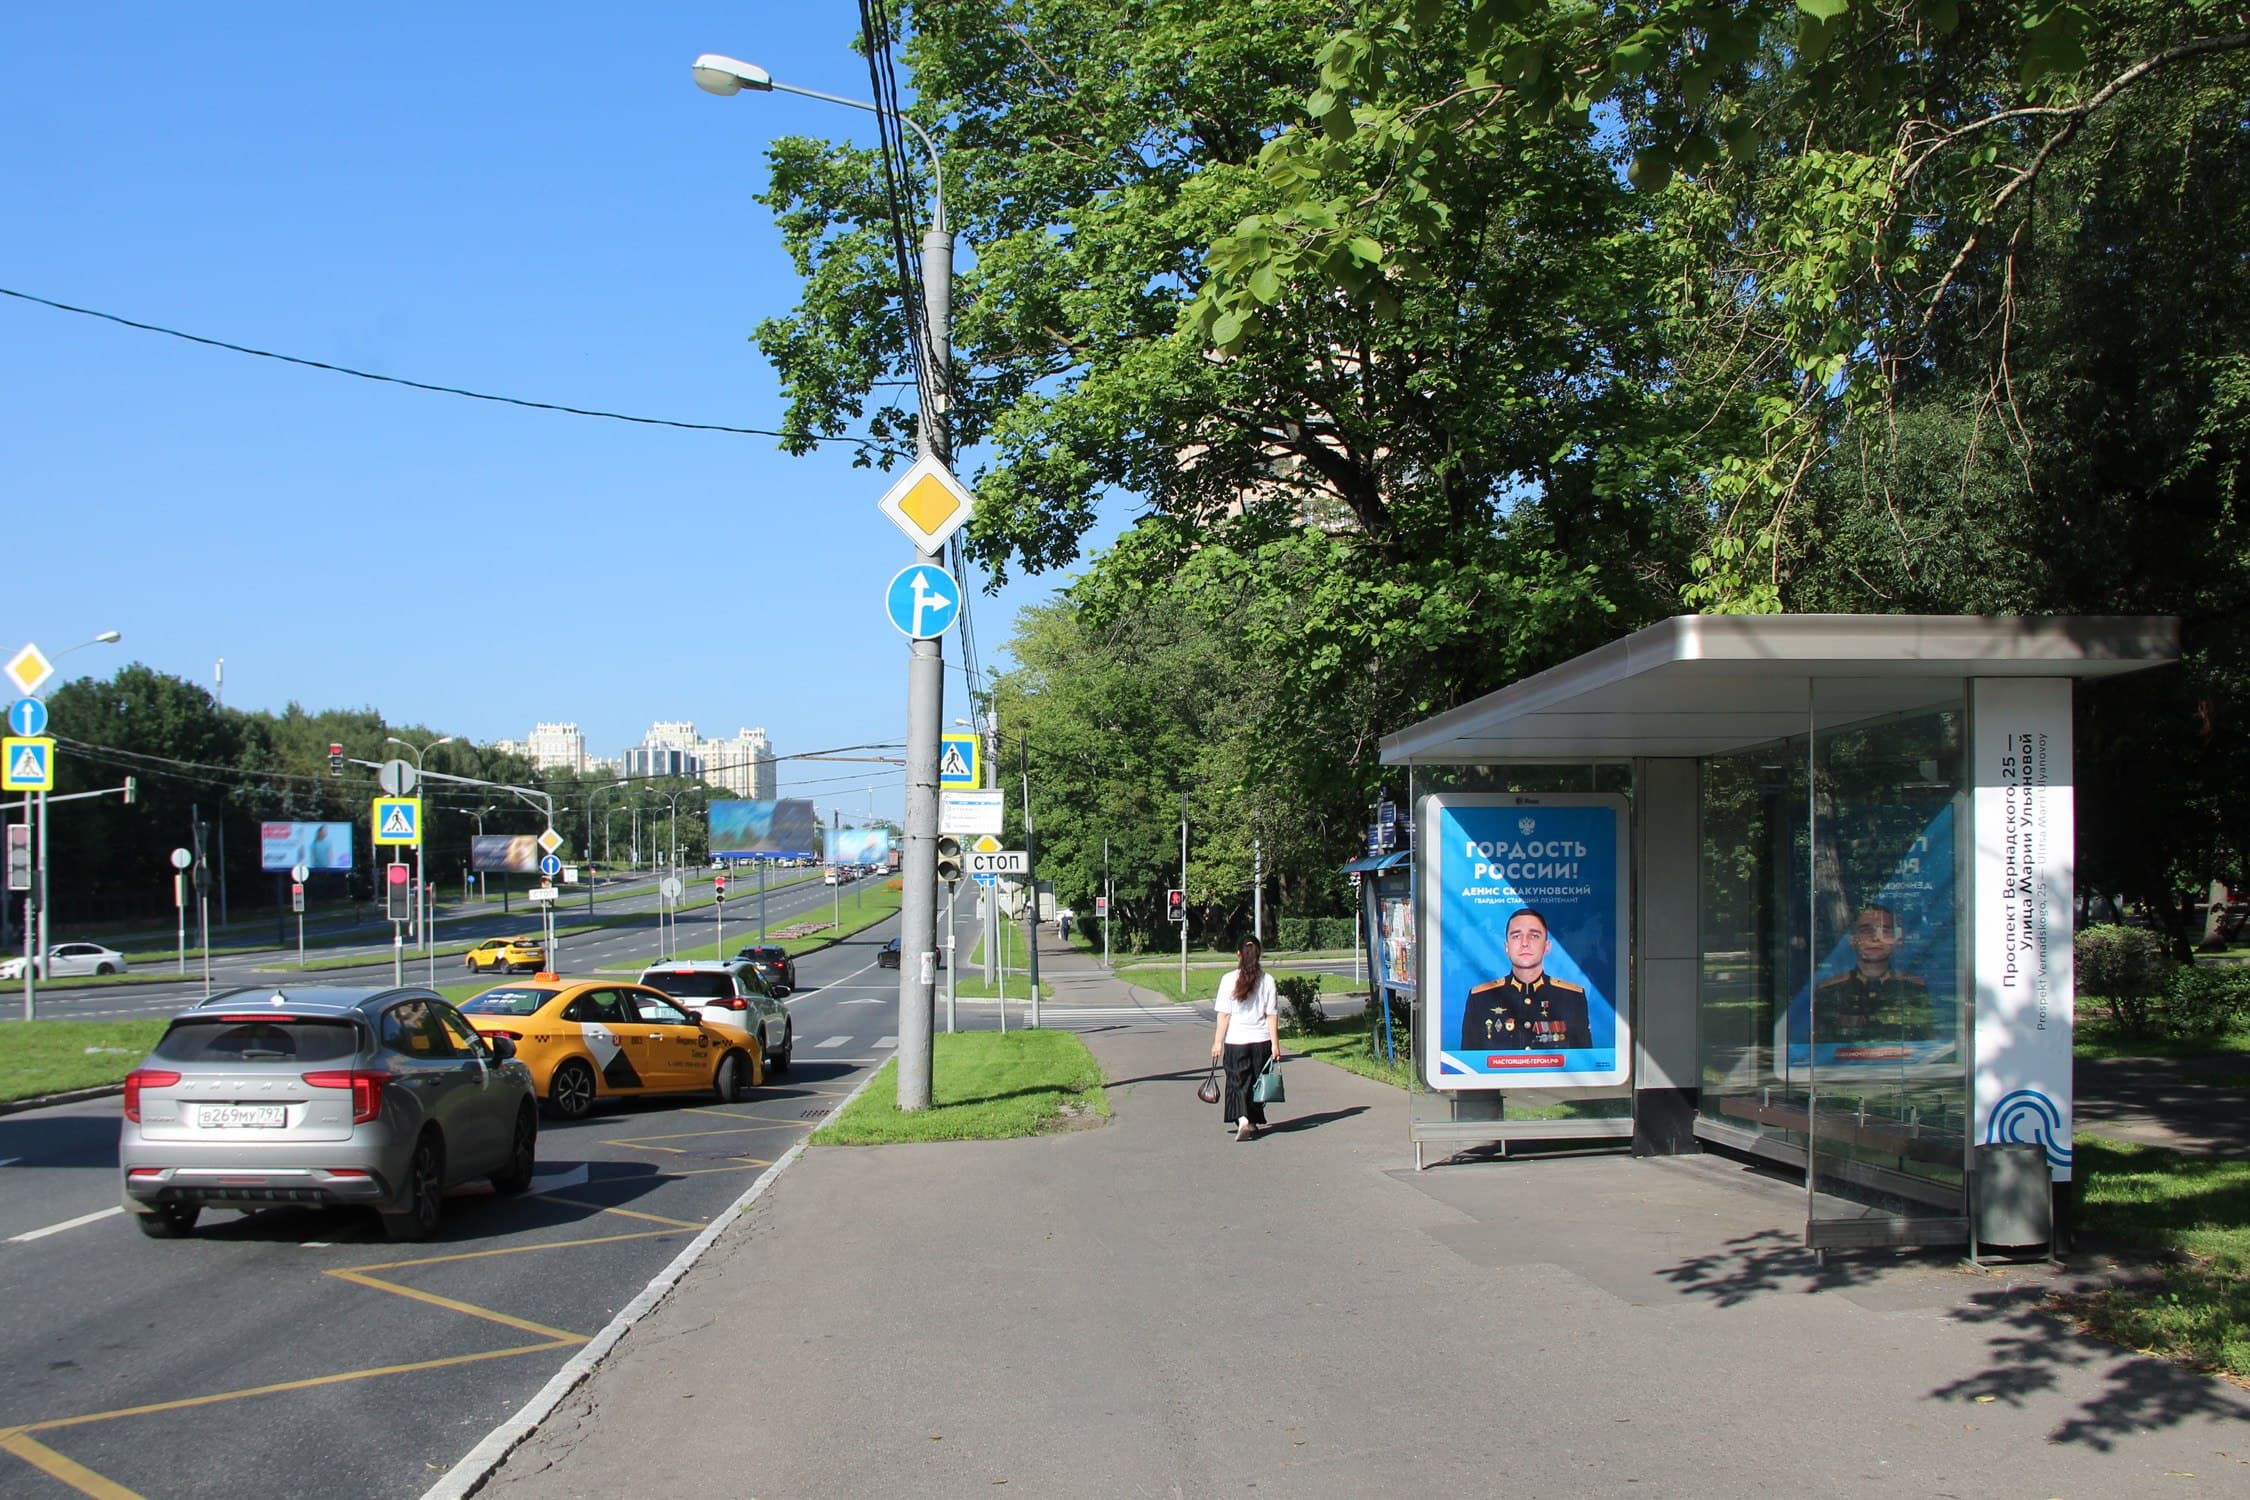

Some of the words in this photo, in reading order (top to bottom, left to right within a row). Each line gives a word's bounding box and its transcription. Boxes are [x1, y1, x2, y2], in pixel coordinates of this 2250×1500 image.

[2002, 756, 2016, 778] 25
[2019, 733, 2033, 828] Ульяновой
[2037, 733, 2048, 792] Ulyanovoy
[974, 855, 1019, 870] СТОП
[1465, 841, 1587, 859] ГОРДОСТЬ
[2003, 783, 2018, 899] Вернадского,
[2019, 833, 2034, 894] Марии
[1462, 887, 1500, 897] ДЕНИС
[1502, 884, 1591, 896] СКАКУНОВСКИЙ
[1474, 863, 1579, 879] РОССИИ!
[2037, 883, 2046, 896] 25
[2003, 904, 2018, 988] Проспект
[2020, 899, 2035, 951] Улица
[2037, 900, 2048, 977] Vernadskogo,
[2037, 979, 2048, 1031] Prospekt
[259, 1107, 281, 1119] 797
